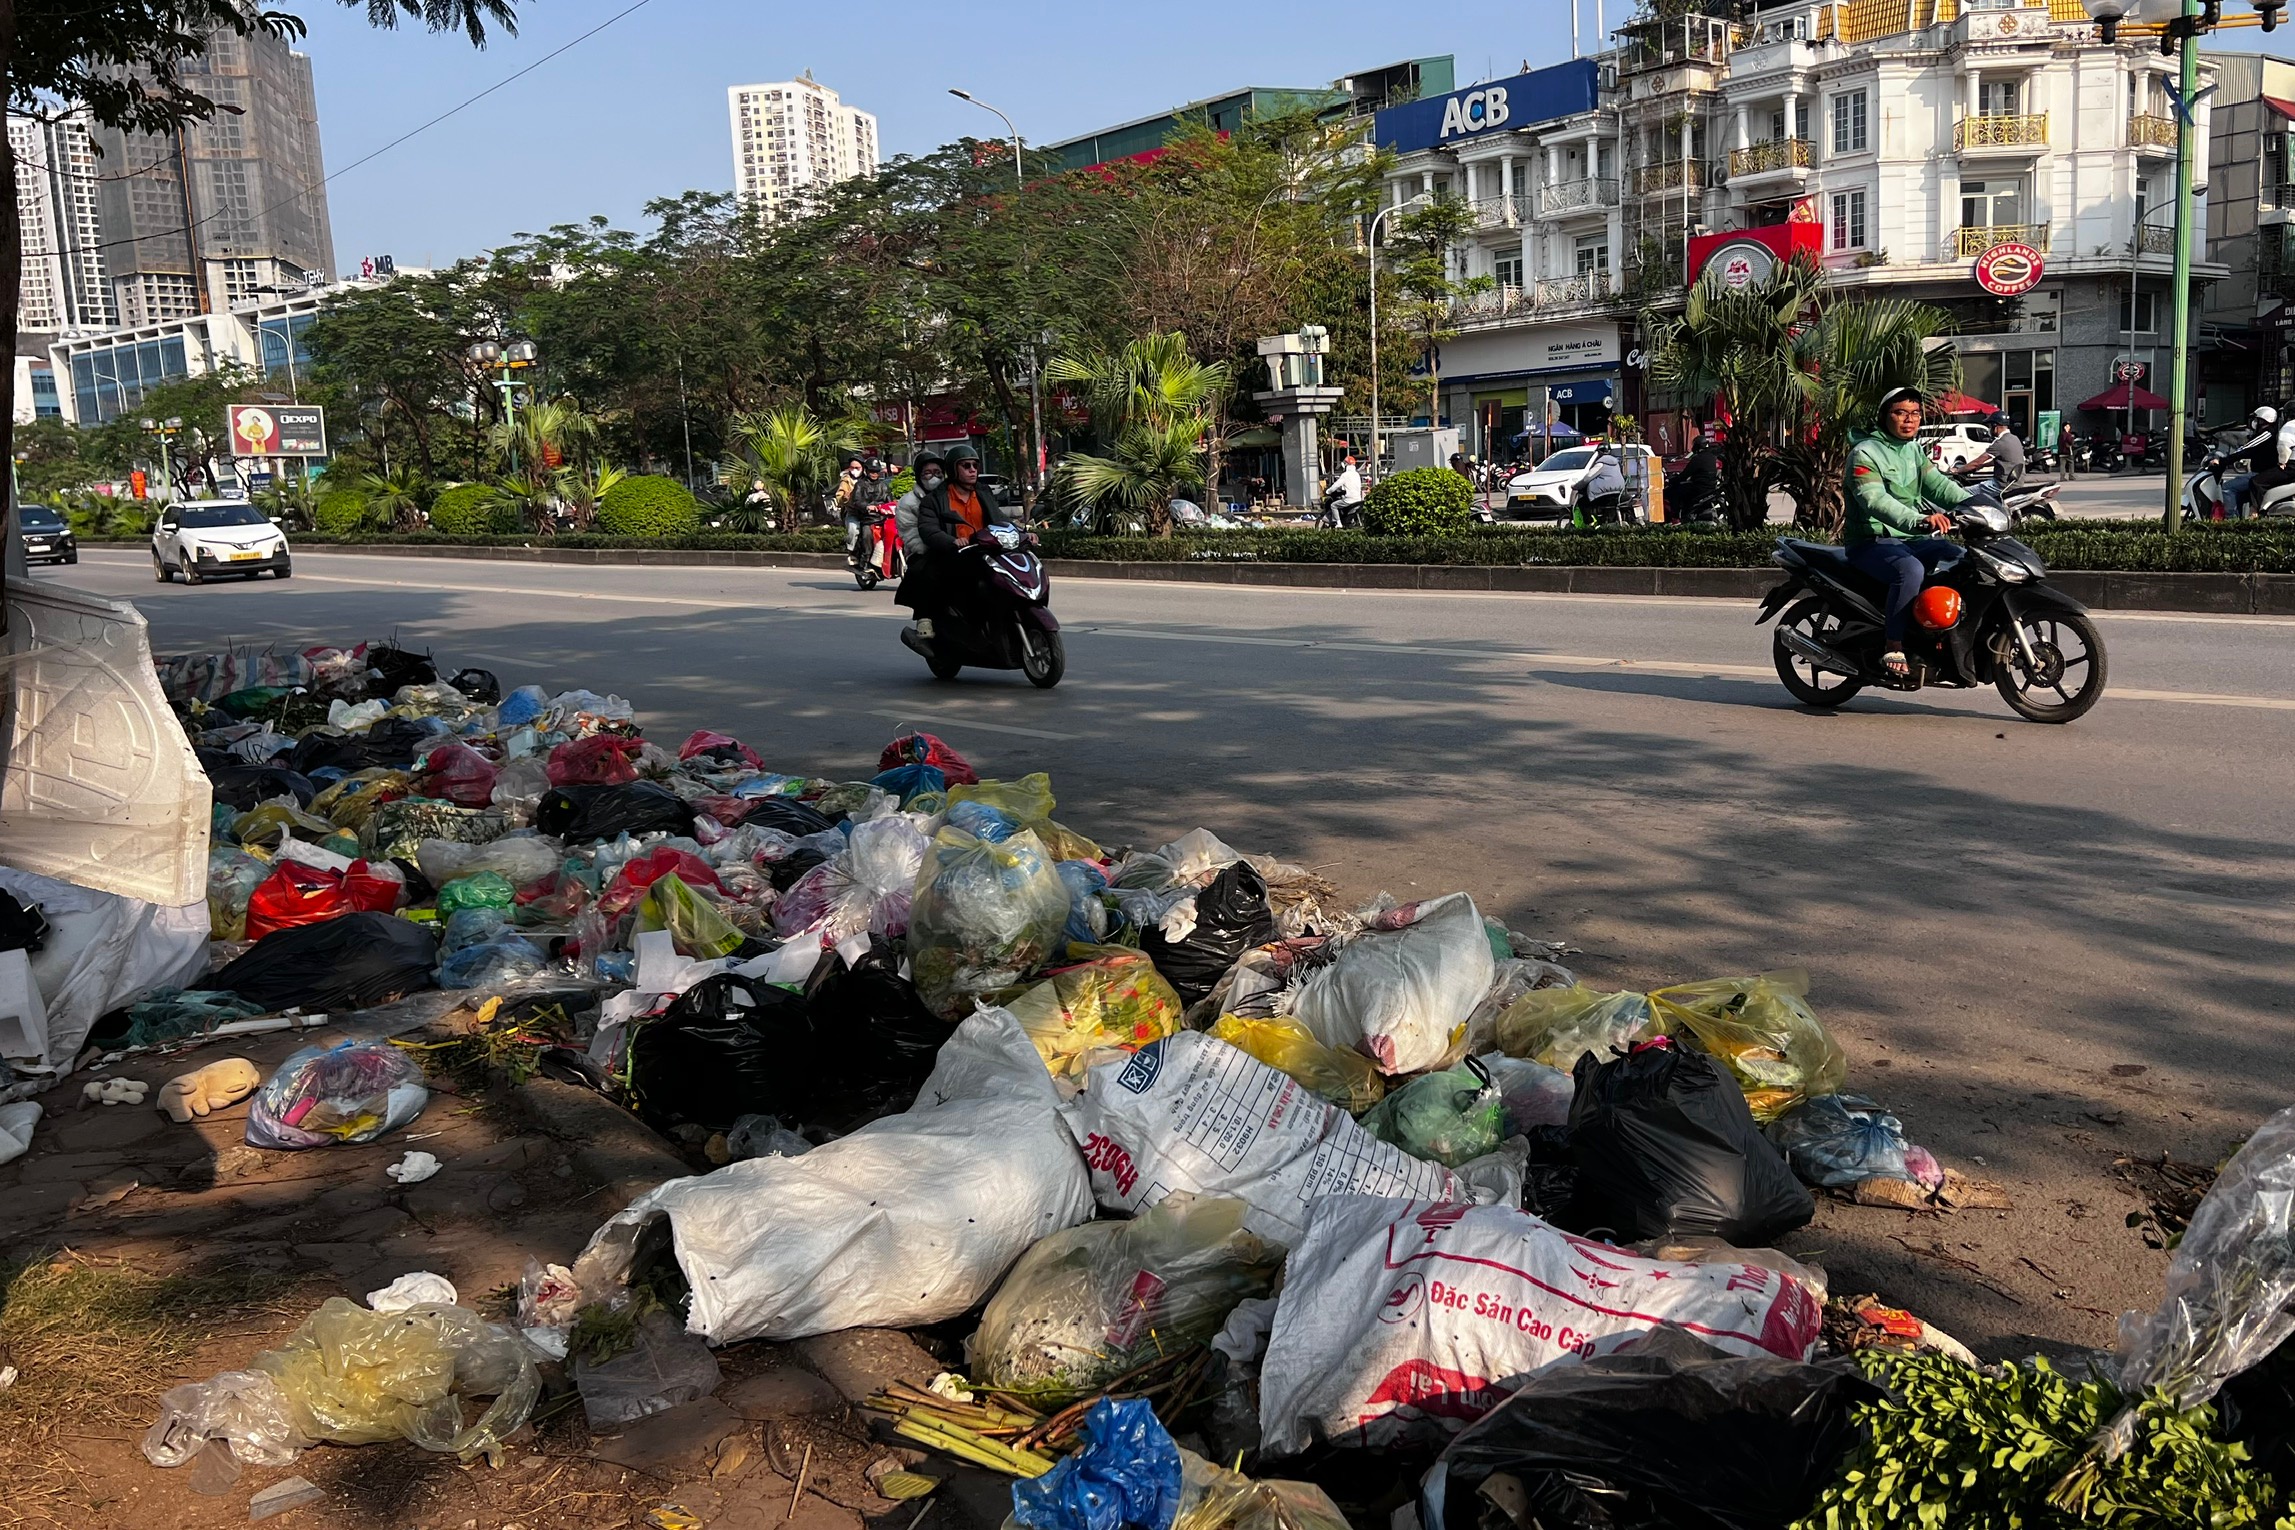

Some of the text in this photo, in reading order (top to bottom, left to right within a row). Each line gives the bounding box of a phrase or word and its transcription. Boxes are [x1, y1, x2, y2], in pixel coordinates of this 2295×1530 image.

[1440, 87, 1509, 138] ACB
[374, 254, 394, 275] MB
[1980, 246, 2040, 269] HIGHLANDS
[1987, 279, 2033, 293] COFFEE
[1548, 343, 1563, 352] NGÂN
[1565, 341, 1580, 350] HÀNG
[1587, 339, 1602, 348] CHÂU
[1556, 388, 1573, 400] ACB
[1172, 1113, 1190, 1133] trong
[1231, 1125, 1253, 1155] H9032
[1315, 1151, 1326, 1168] 150
[1305, 1168, 1318, 1188] ppm
[1321, 1166, 1336, 1186] 14%
[1430, 1281, 1596, 1360] Đặc Sản Cao Cấp
